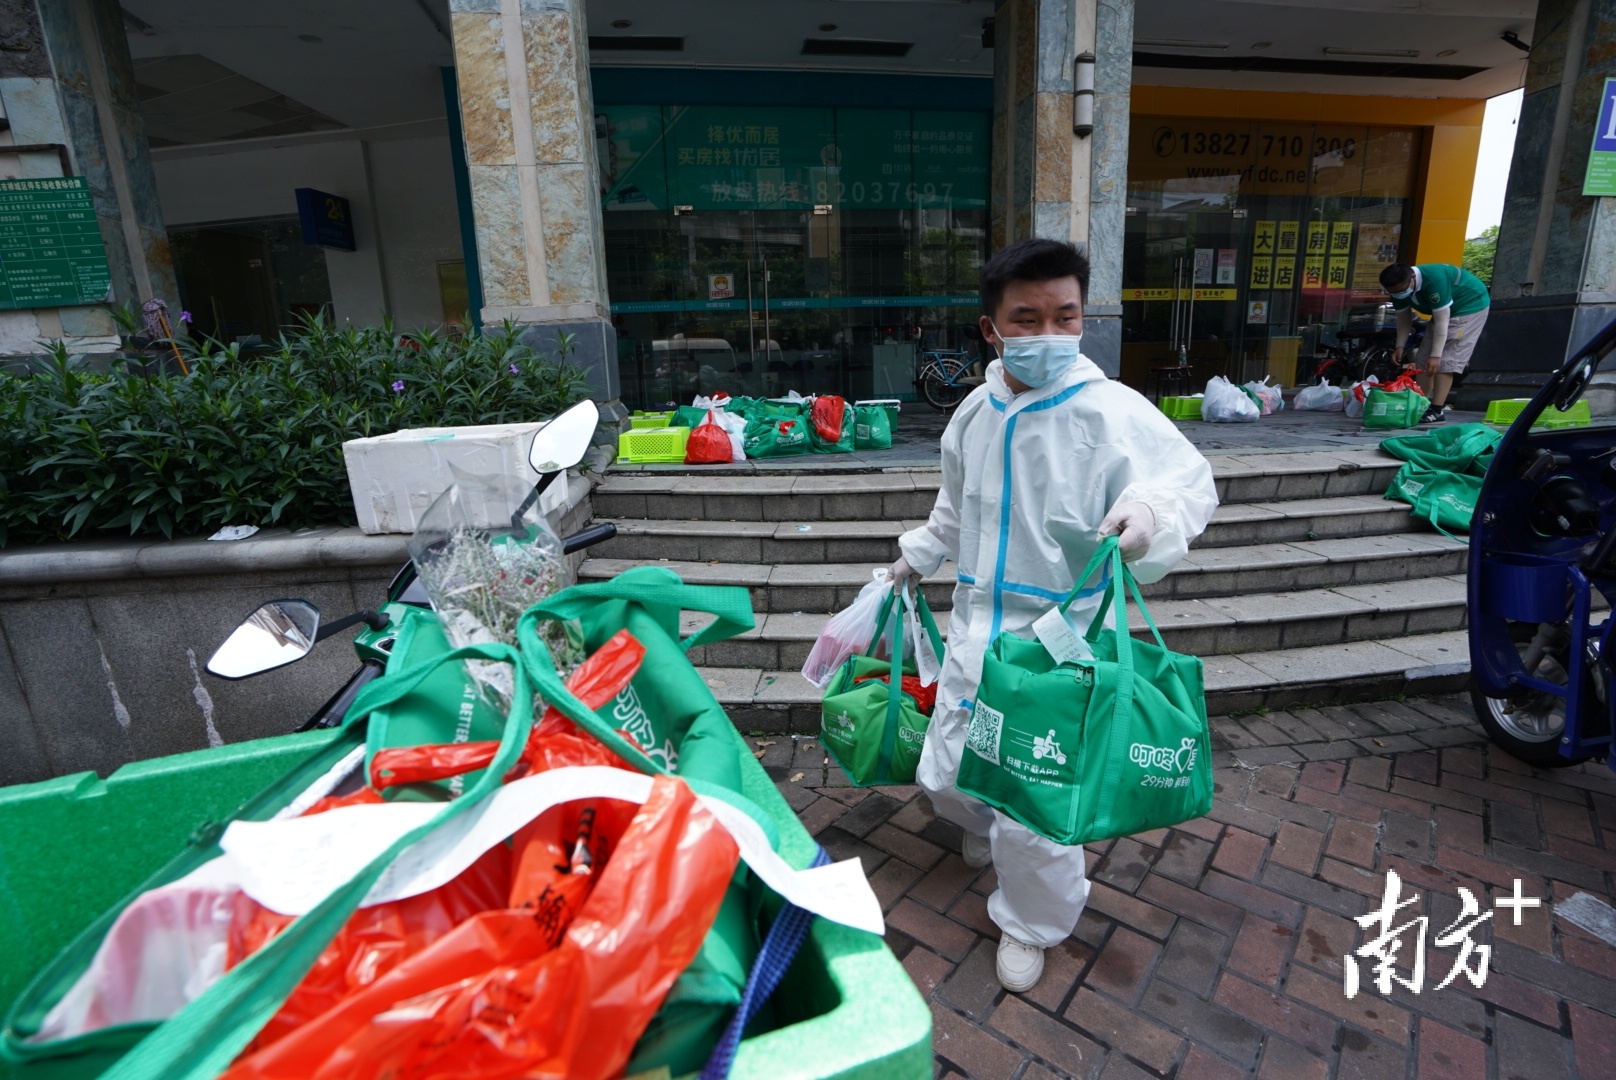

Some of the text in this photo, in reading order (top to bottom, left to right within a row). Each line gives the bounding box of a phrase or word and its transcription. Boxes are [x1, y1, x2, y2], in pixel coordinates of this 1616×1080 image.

[707, 125, 779, 145] 择优而居
[893, 130, 973, 142] 万千家庭的品质见证
[1181, 131, 1251, 156] 13827
[1262, 135, 1303, 158] 710
[677, 147, 780, 166] 买房找优居
[893, 143, 973, 154] 始终如一的用心服务
[1256, 231, 1349, 250] 大量房源
[1253, 265, 1345, 285] 进店咨询
[1006, 755, 1059, 777] 扫描下载APP
[1040, 779, 1063, 788] HAPPIER
